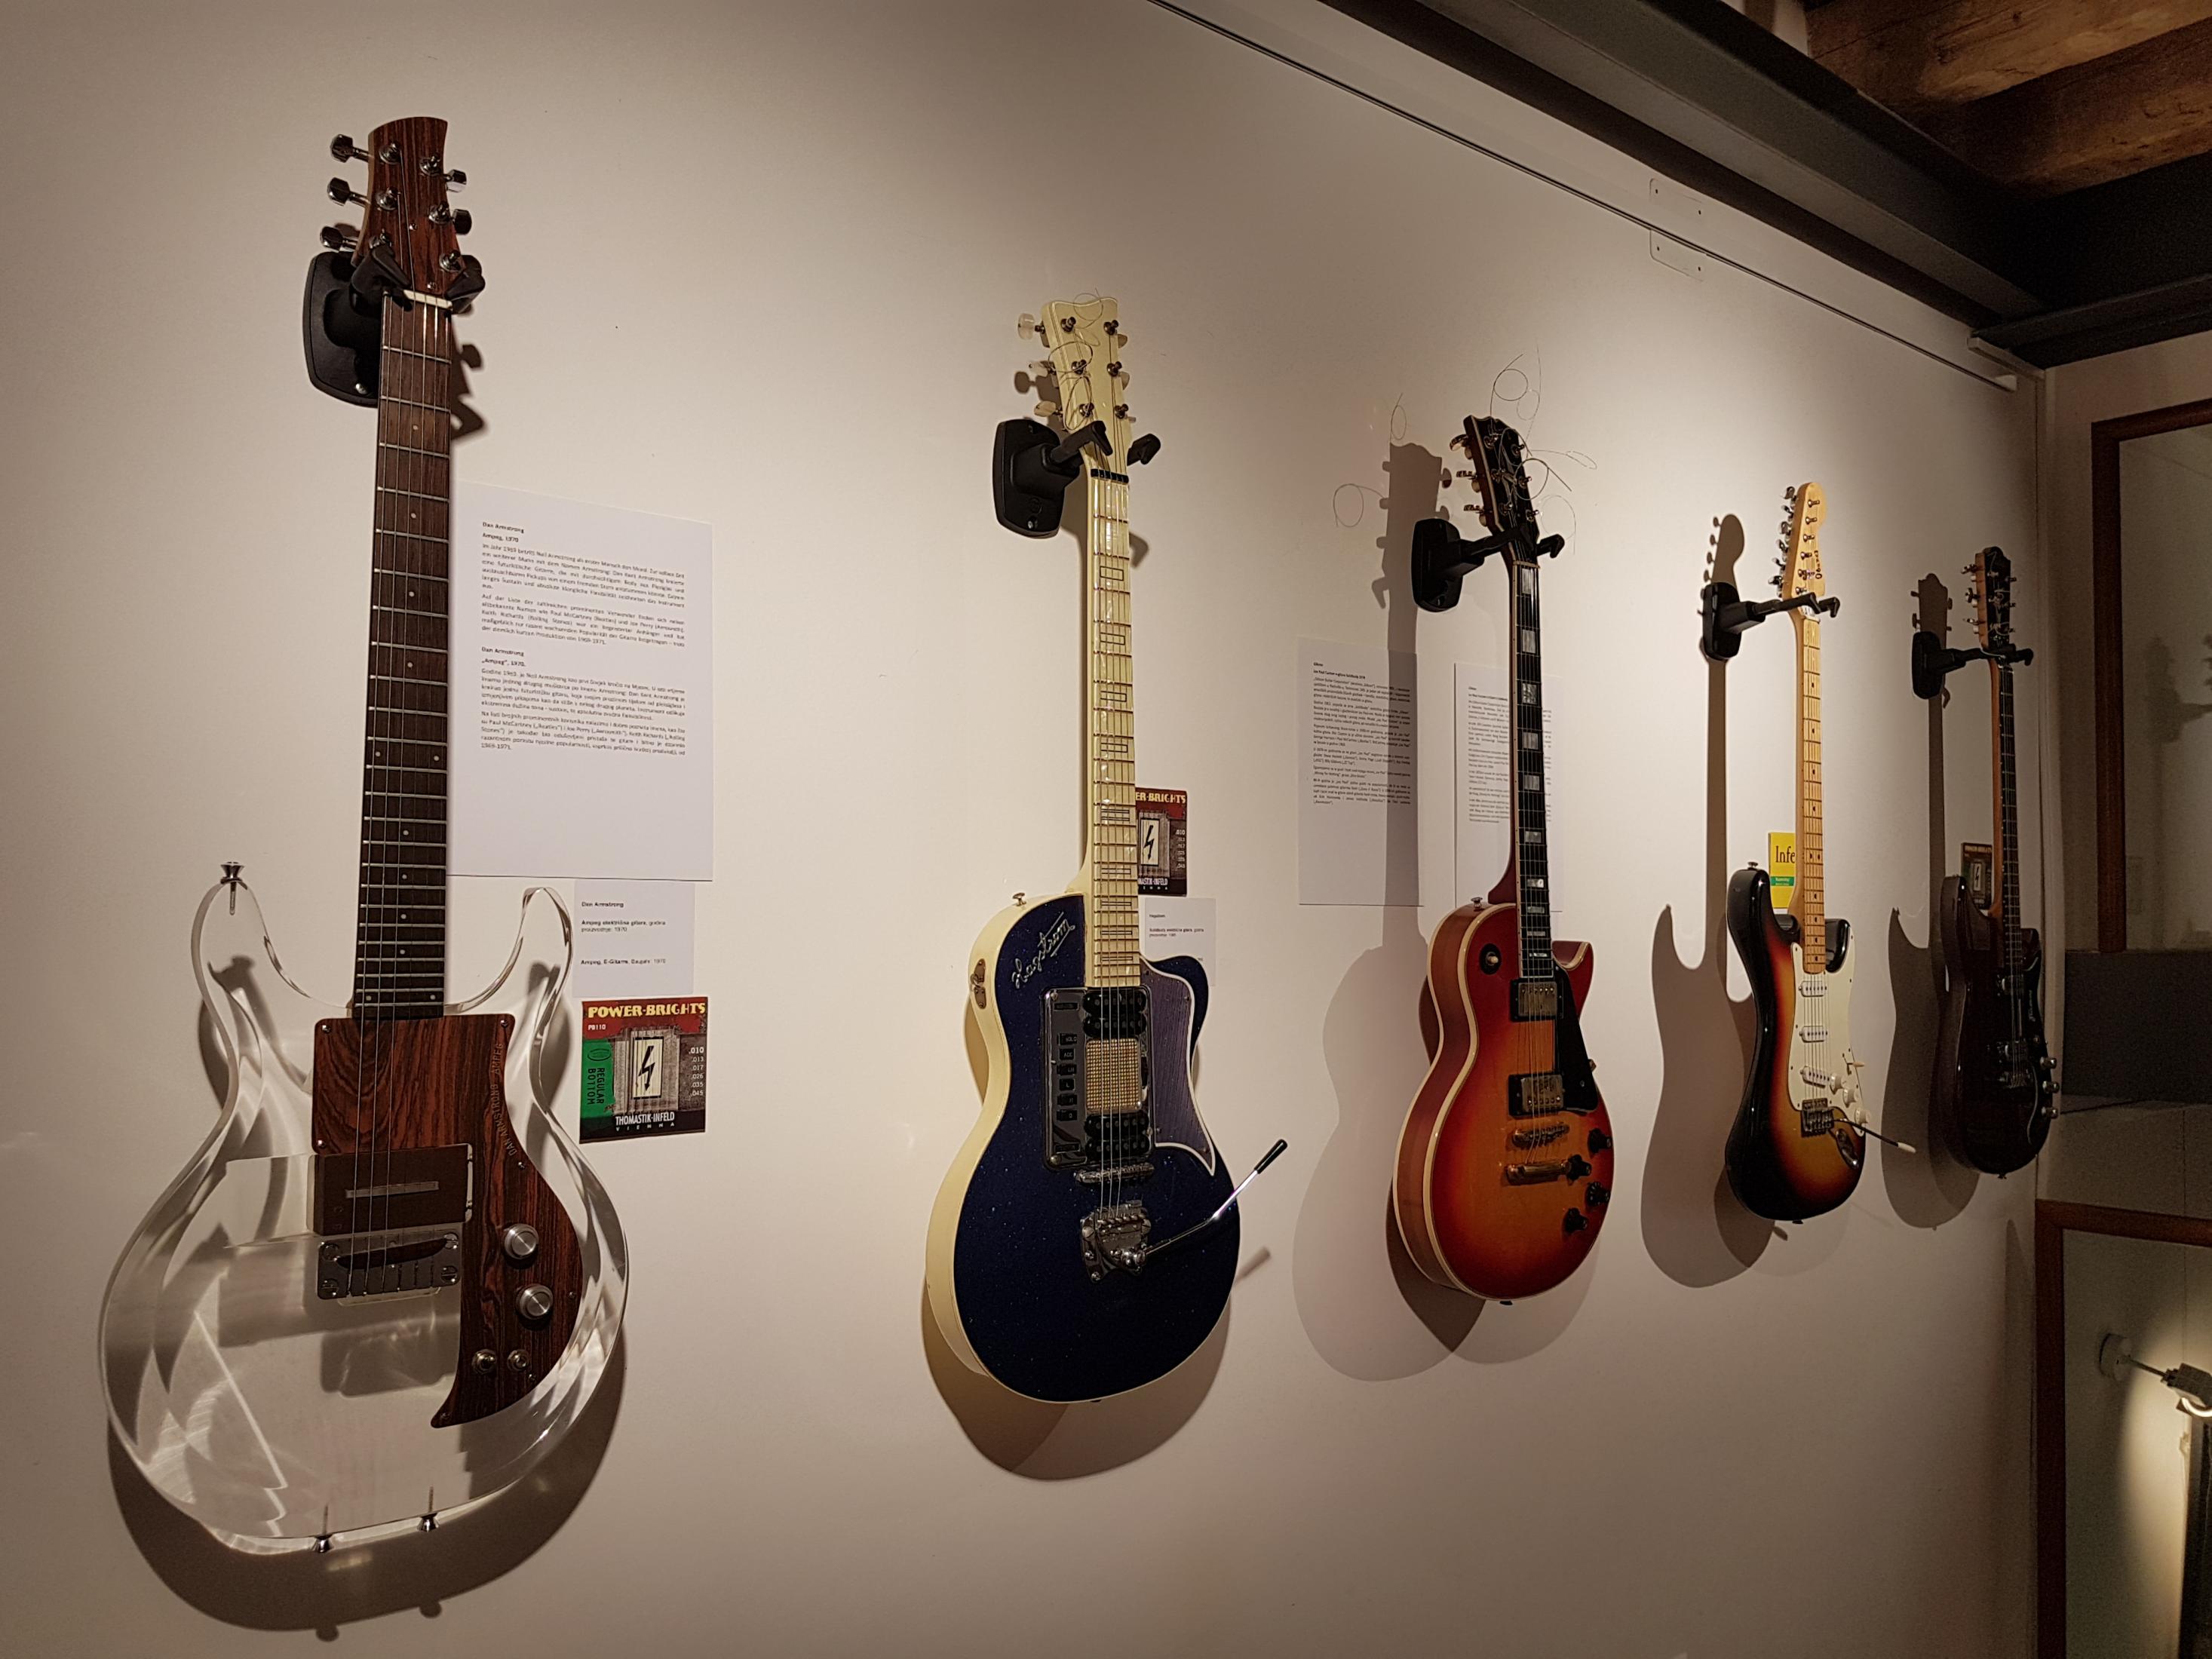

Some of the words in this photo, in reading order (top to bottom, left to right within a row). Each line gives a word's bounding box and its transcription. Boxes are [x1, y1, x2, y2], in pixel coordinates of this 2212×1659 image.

[495, 523, 524, 534] Armstrong
[494, 648, 524, 658] Armstrong
[1775, 845, 1796, 863] Infe
[588, 1002, 706, 1018] POWER-BRIGHTS
[587, 1068, 597, 1105] BOTTOM
[597, 1067, 605, 1104] REGULAR
[615, 1112, 675, 1126] THOMASTIK-INFELD
[615, 1122, 675, 1132] VIENNA
